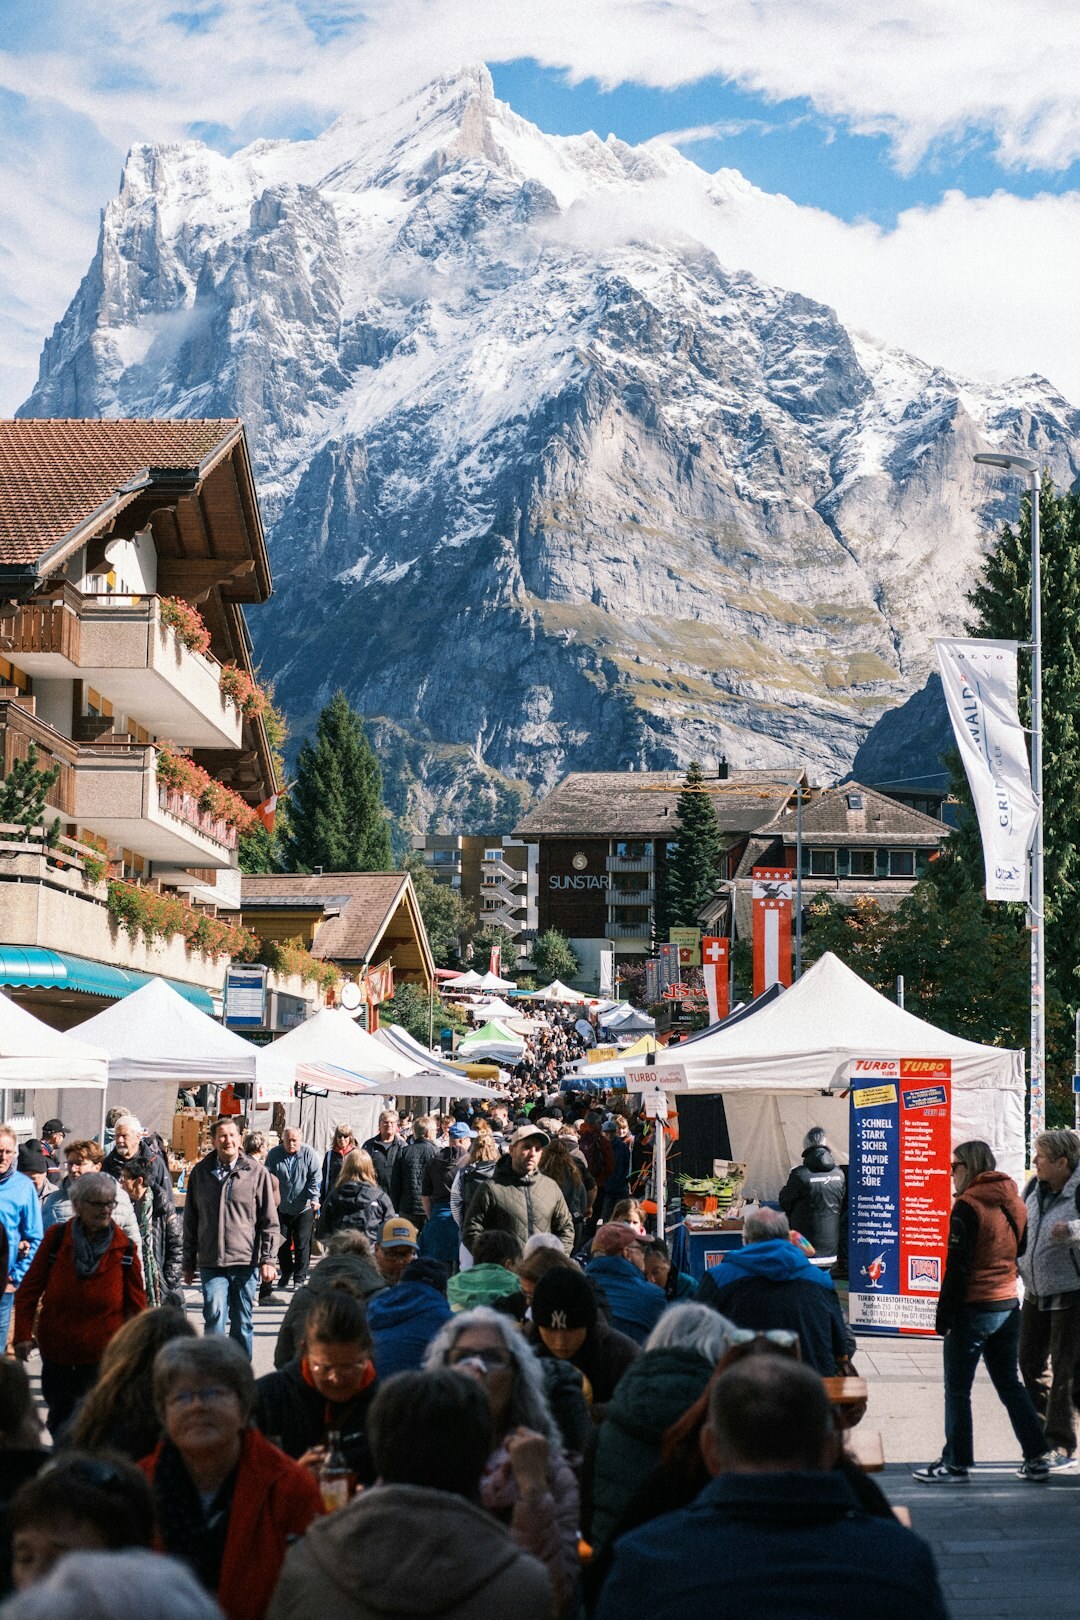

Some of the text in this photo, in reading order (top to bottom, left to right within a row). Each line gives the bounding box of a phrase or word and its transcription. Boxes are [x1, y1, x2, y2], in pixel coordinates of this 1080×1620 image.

[549, 875, 609, 890] SUNSTAR
[855, 1060, 896, 1071] TURBO
[903, 1060, 945, 1072] TURBO
[629, 1072, 658, 1083] TURBO
[861, 1118, 893, 1129] SCHNELL
[861, 1129, 886, 1140] STARK
[861, 1141, 888, 1151] SICHER
[861, 1154, 889, 1165] RAPIDE
[861, 1165, 885, 1175] FORTE
[861, 1175, 881, 1187] SÛRE
[911, 1259, 939, 1281] TURBO
[857, 1294, 875, 1302] TURBO
[876, 1295, 926, 1305] KLEBSTOFFTECHNIK
